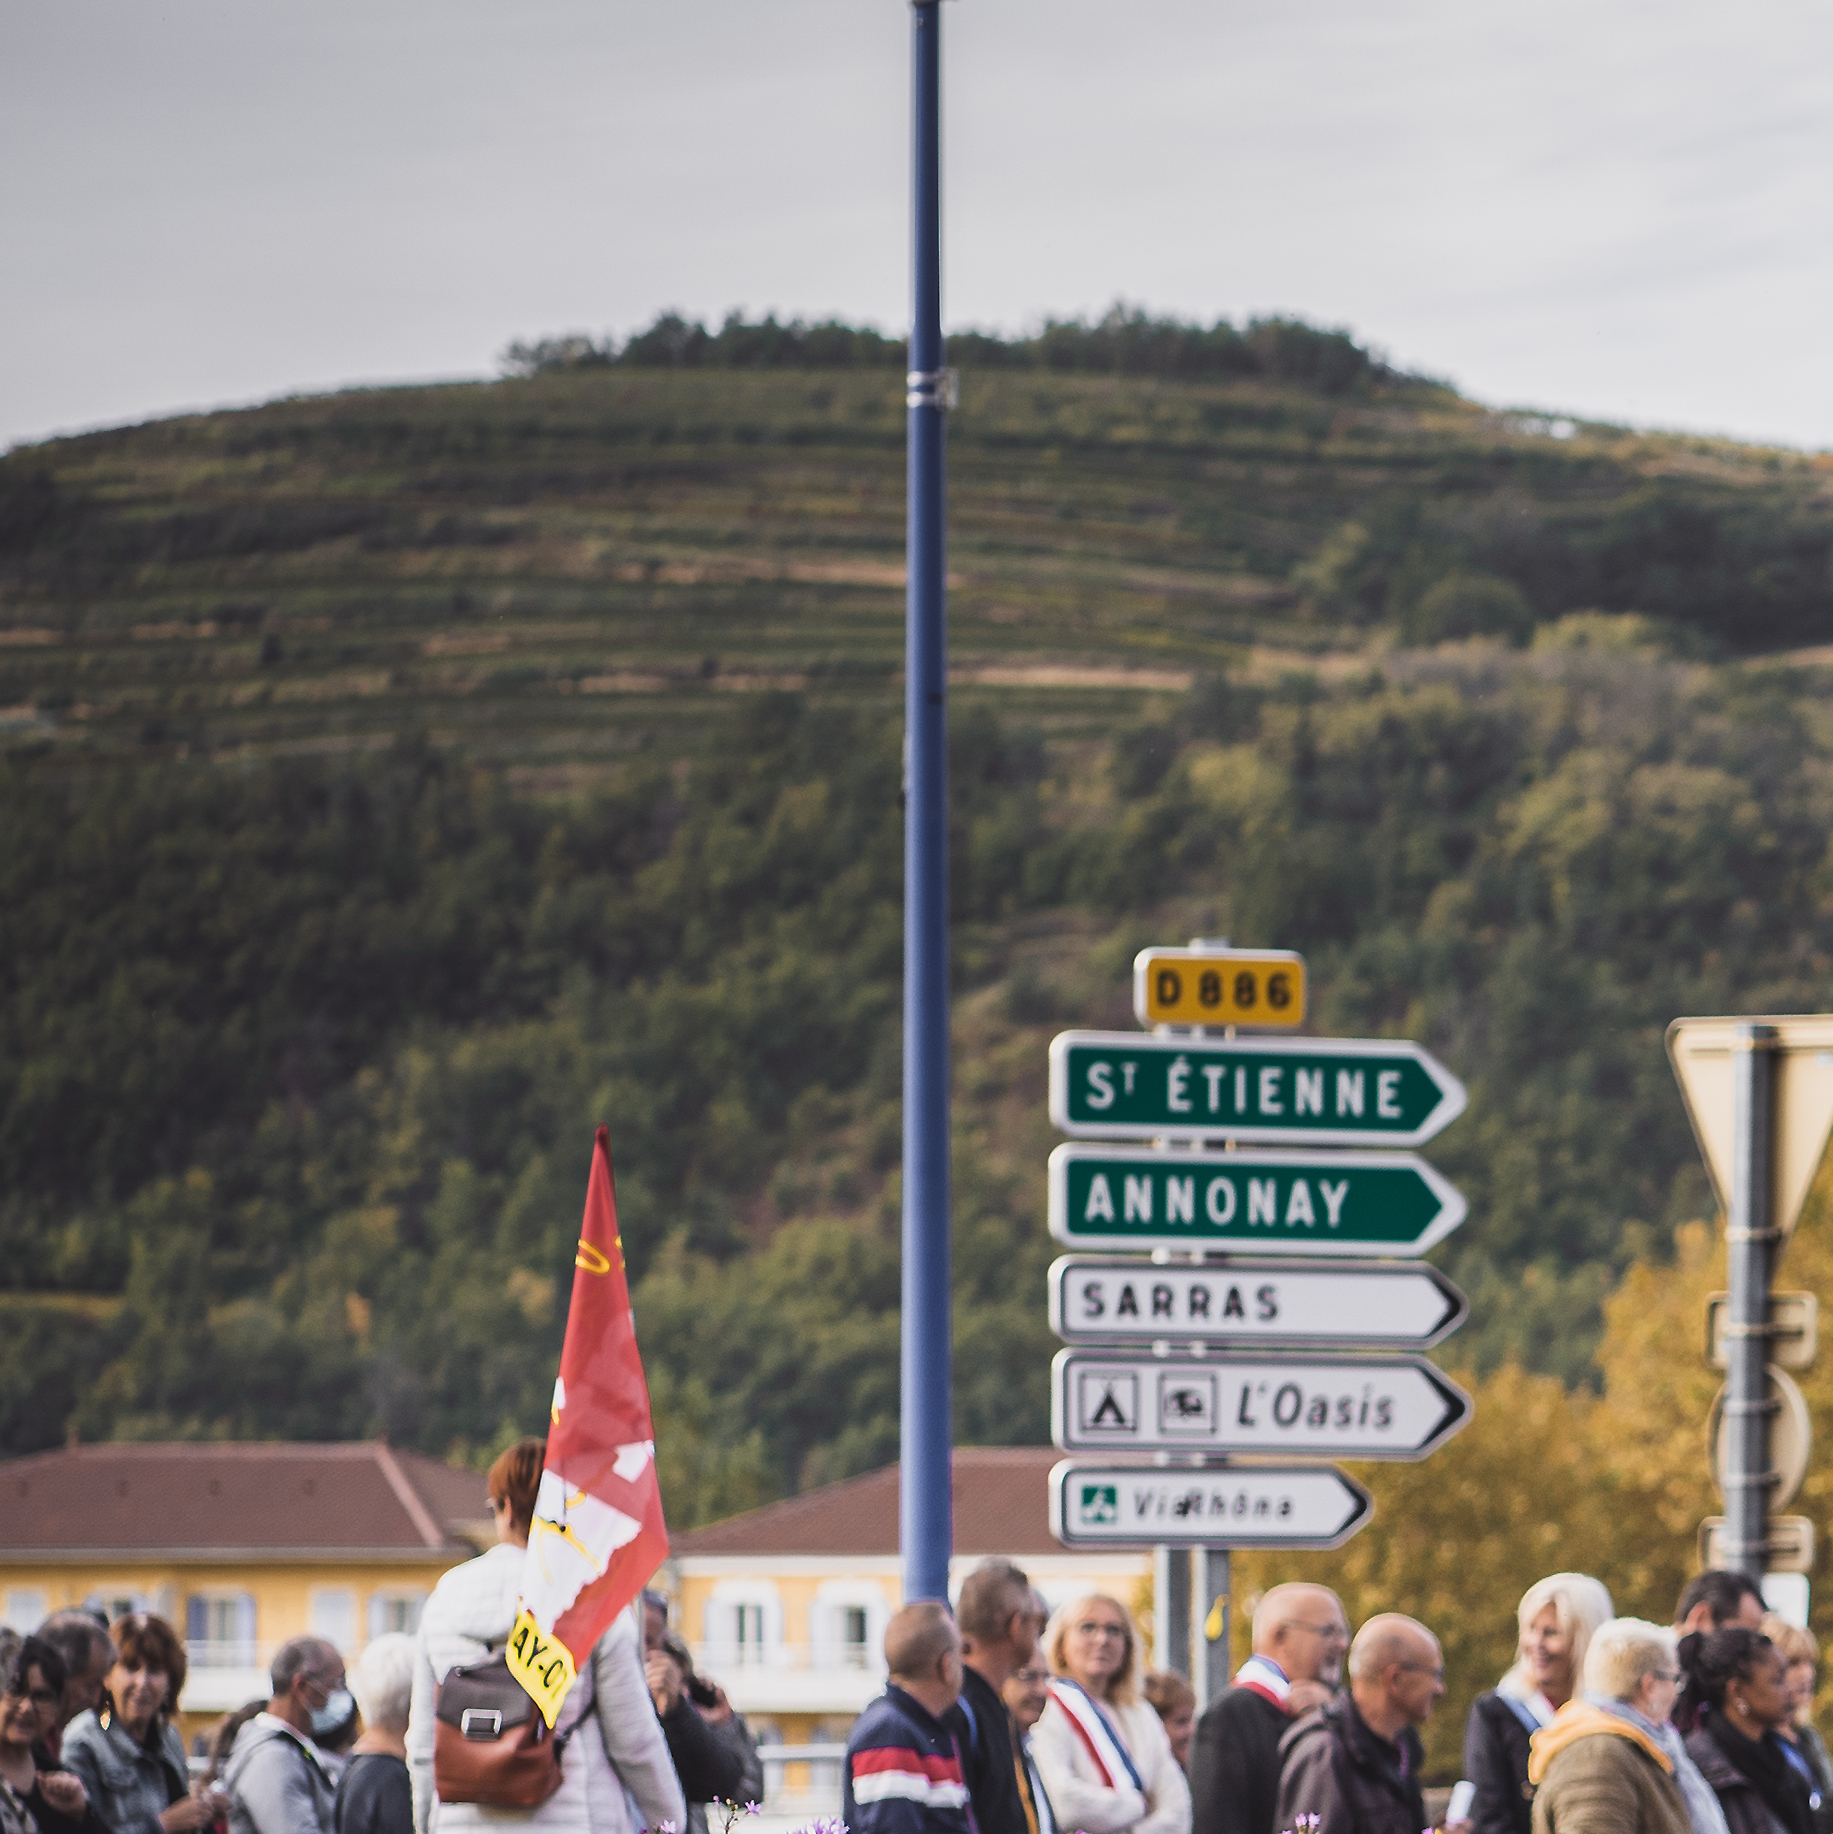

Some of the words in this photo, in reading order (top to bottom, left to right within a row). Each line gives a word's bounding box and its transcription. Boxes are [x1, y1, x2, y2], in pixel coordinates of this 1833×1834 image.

[1198, 971, 1293, 1011] 886
[1166, 1055, 1405, 1119] ÉTIENNE
[1085, 1175, 1350, 1228] ANNONAY
[1081, 1280, 1280, 1321] SARRAS
[1237, 1380, 1396, 1430] L'Oasis
